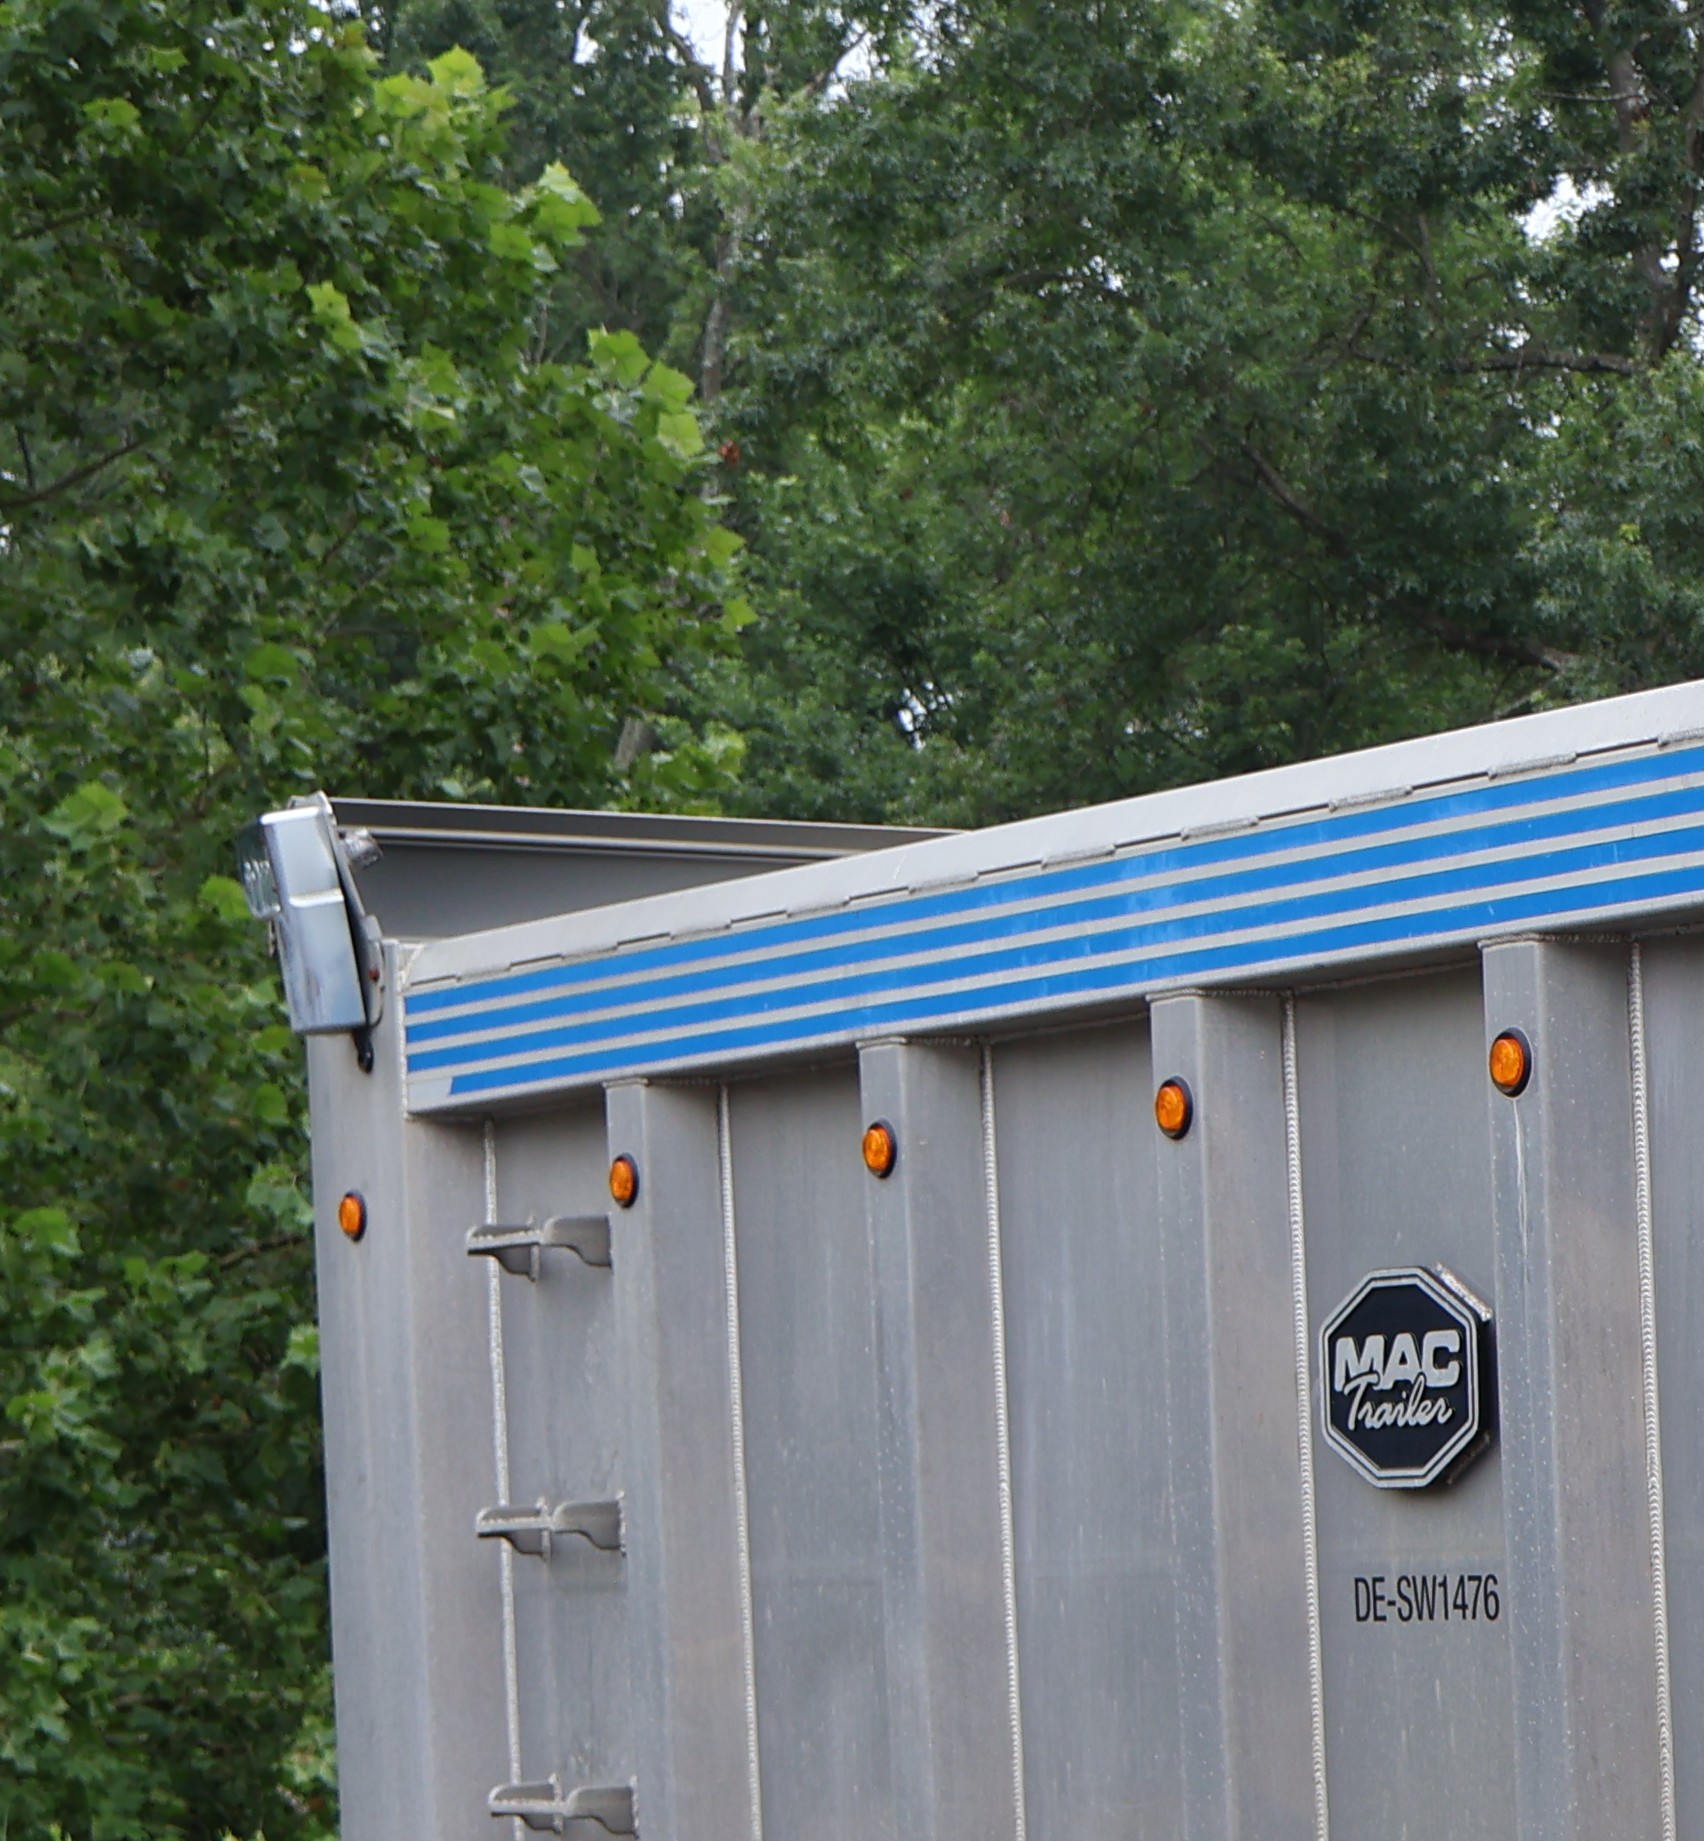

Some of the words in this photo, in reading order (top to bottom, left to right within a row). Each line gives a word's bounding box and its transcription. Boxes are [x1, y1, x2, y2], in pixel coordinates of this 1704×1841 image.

[1334, 1329, 1461, 1391] MAC
[1344, 1374, 1453, 1430] Trailer
[1353, 1573, 1500, 1623] DE-SW1476
